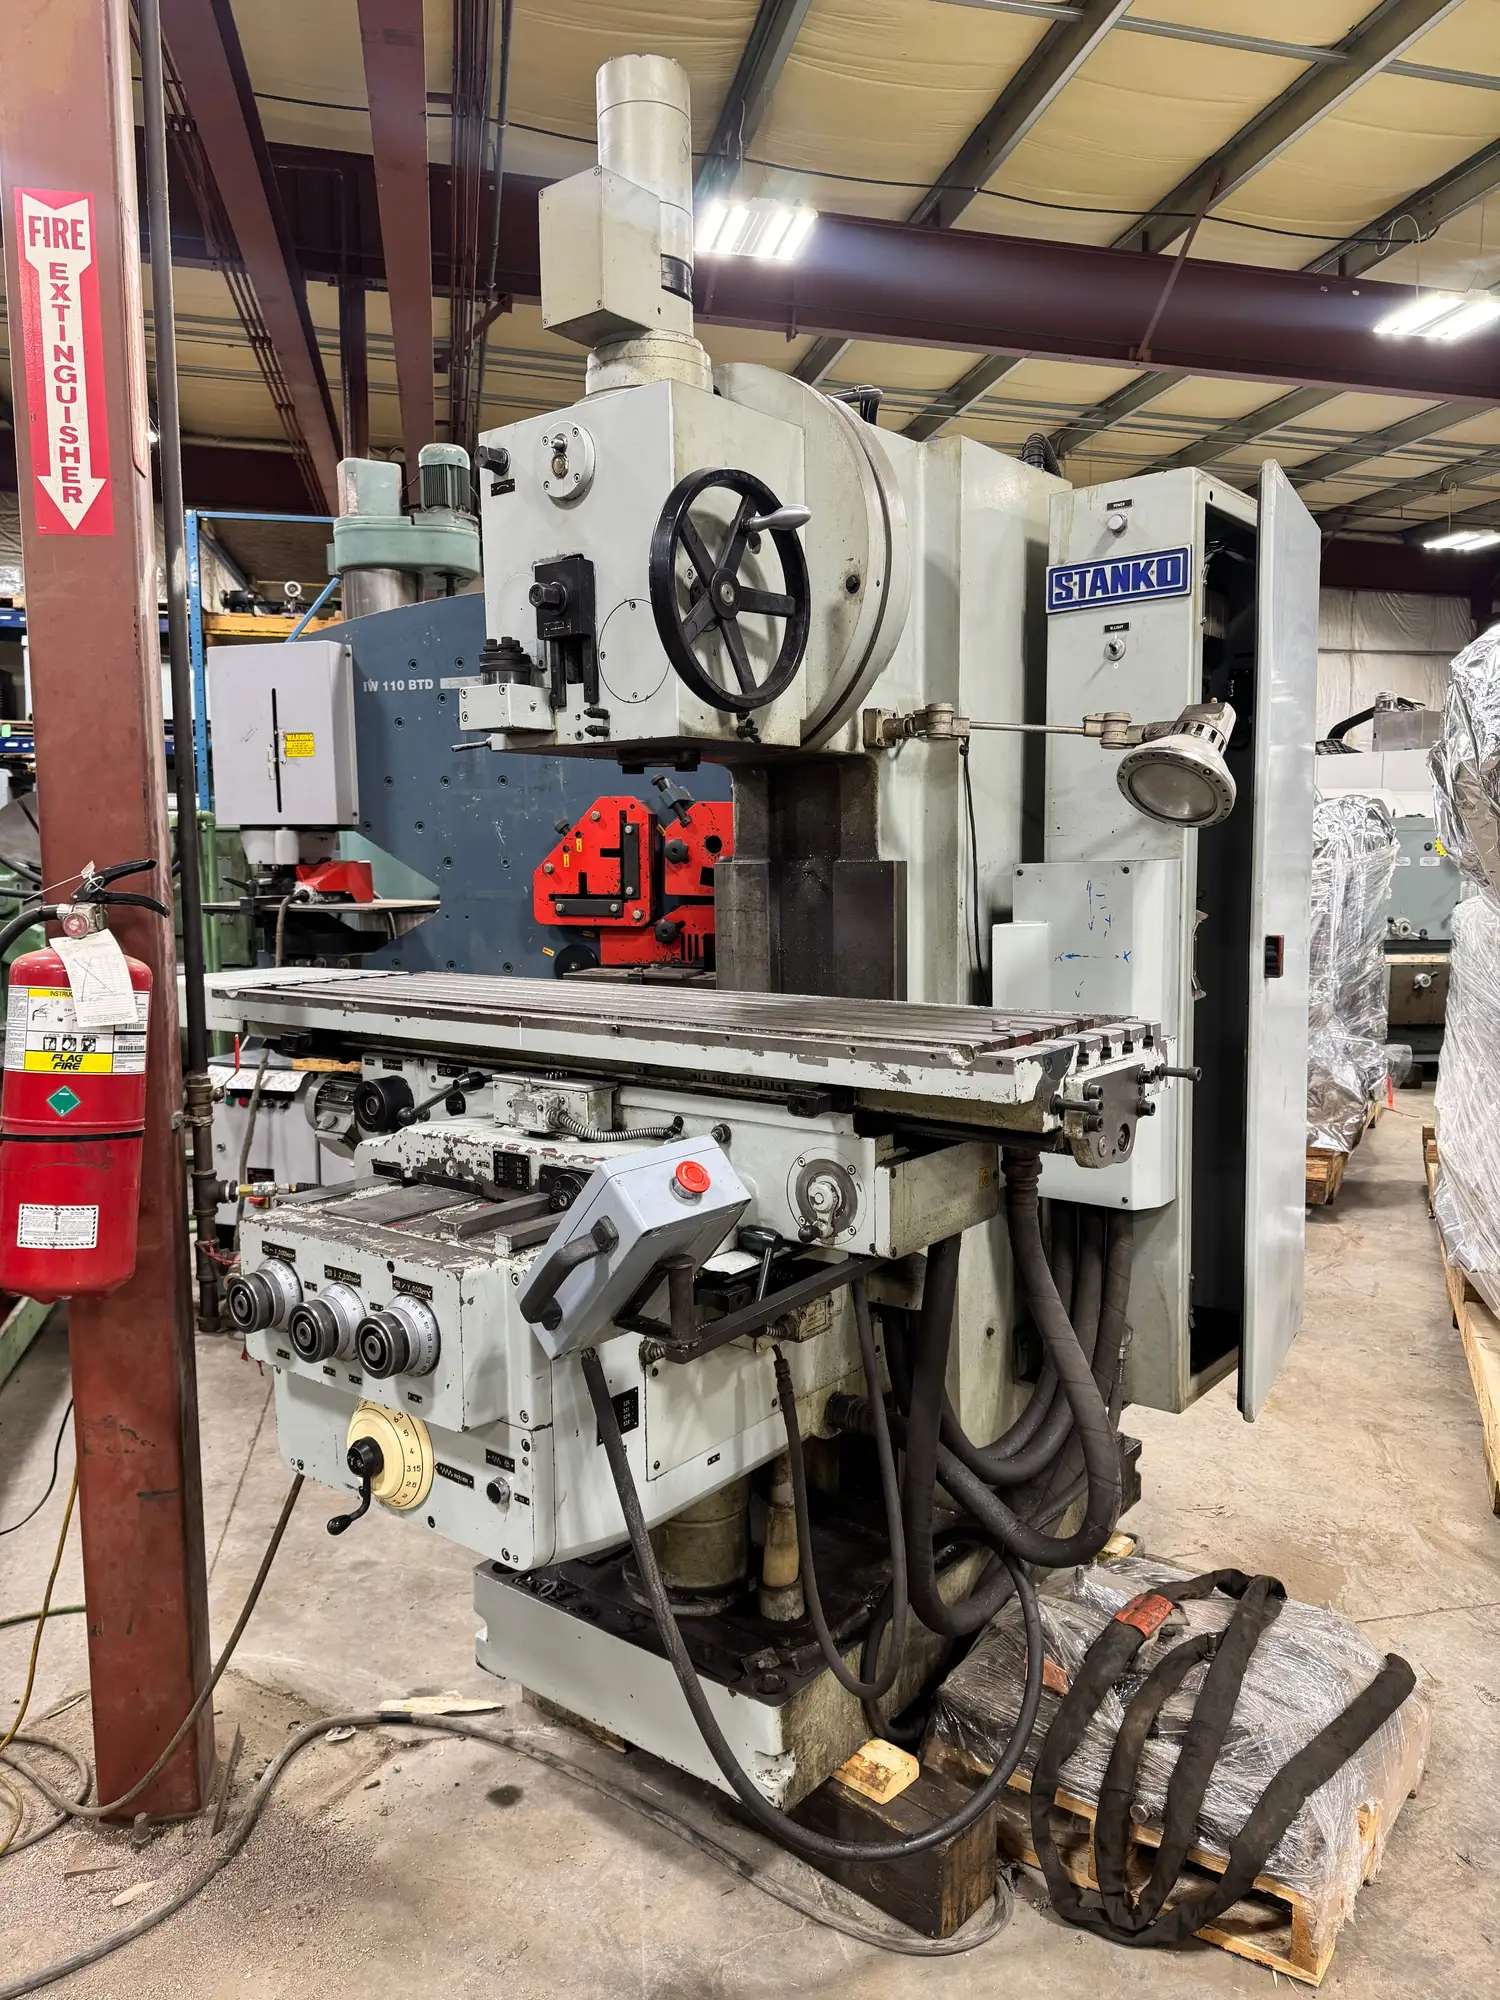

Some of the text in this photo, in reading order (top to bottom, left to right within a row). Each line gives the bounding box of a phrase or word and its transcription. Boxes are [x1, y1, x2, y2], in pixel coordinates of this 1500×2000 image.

[28, 215, 86, 251] FIRE
[49, 262, 84, 504] EXTINGUISHER
[1054, 556, 1181, 602] STANKO
[363, 679, 434, 692] IW 110 BTD
[51, 1054, 84, 1062] FLAG
[53, 1062, 81, 1070] FIRE
[403, 1429, 409, 1437] 5
